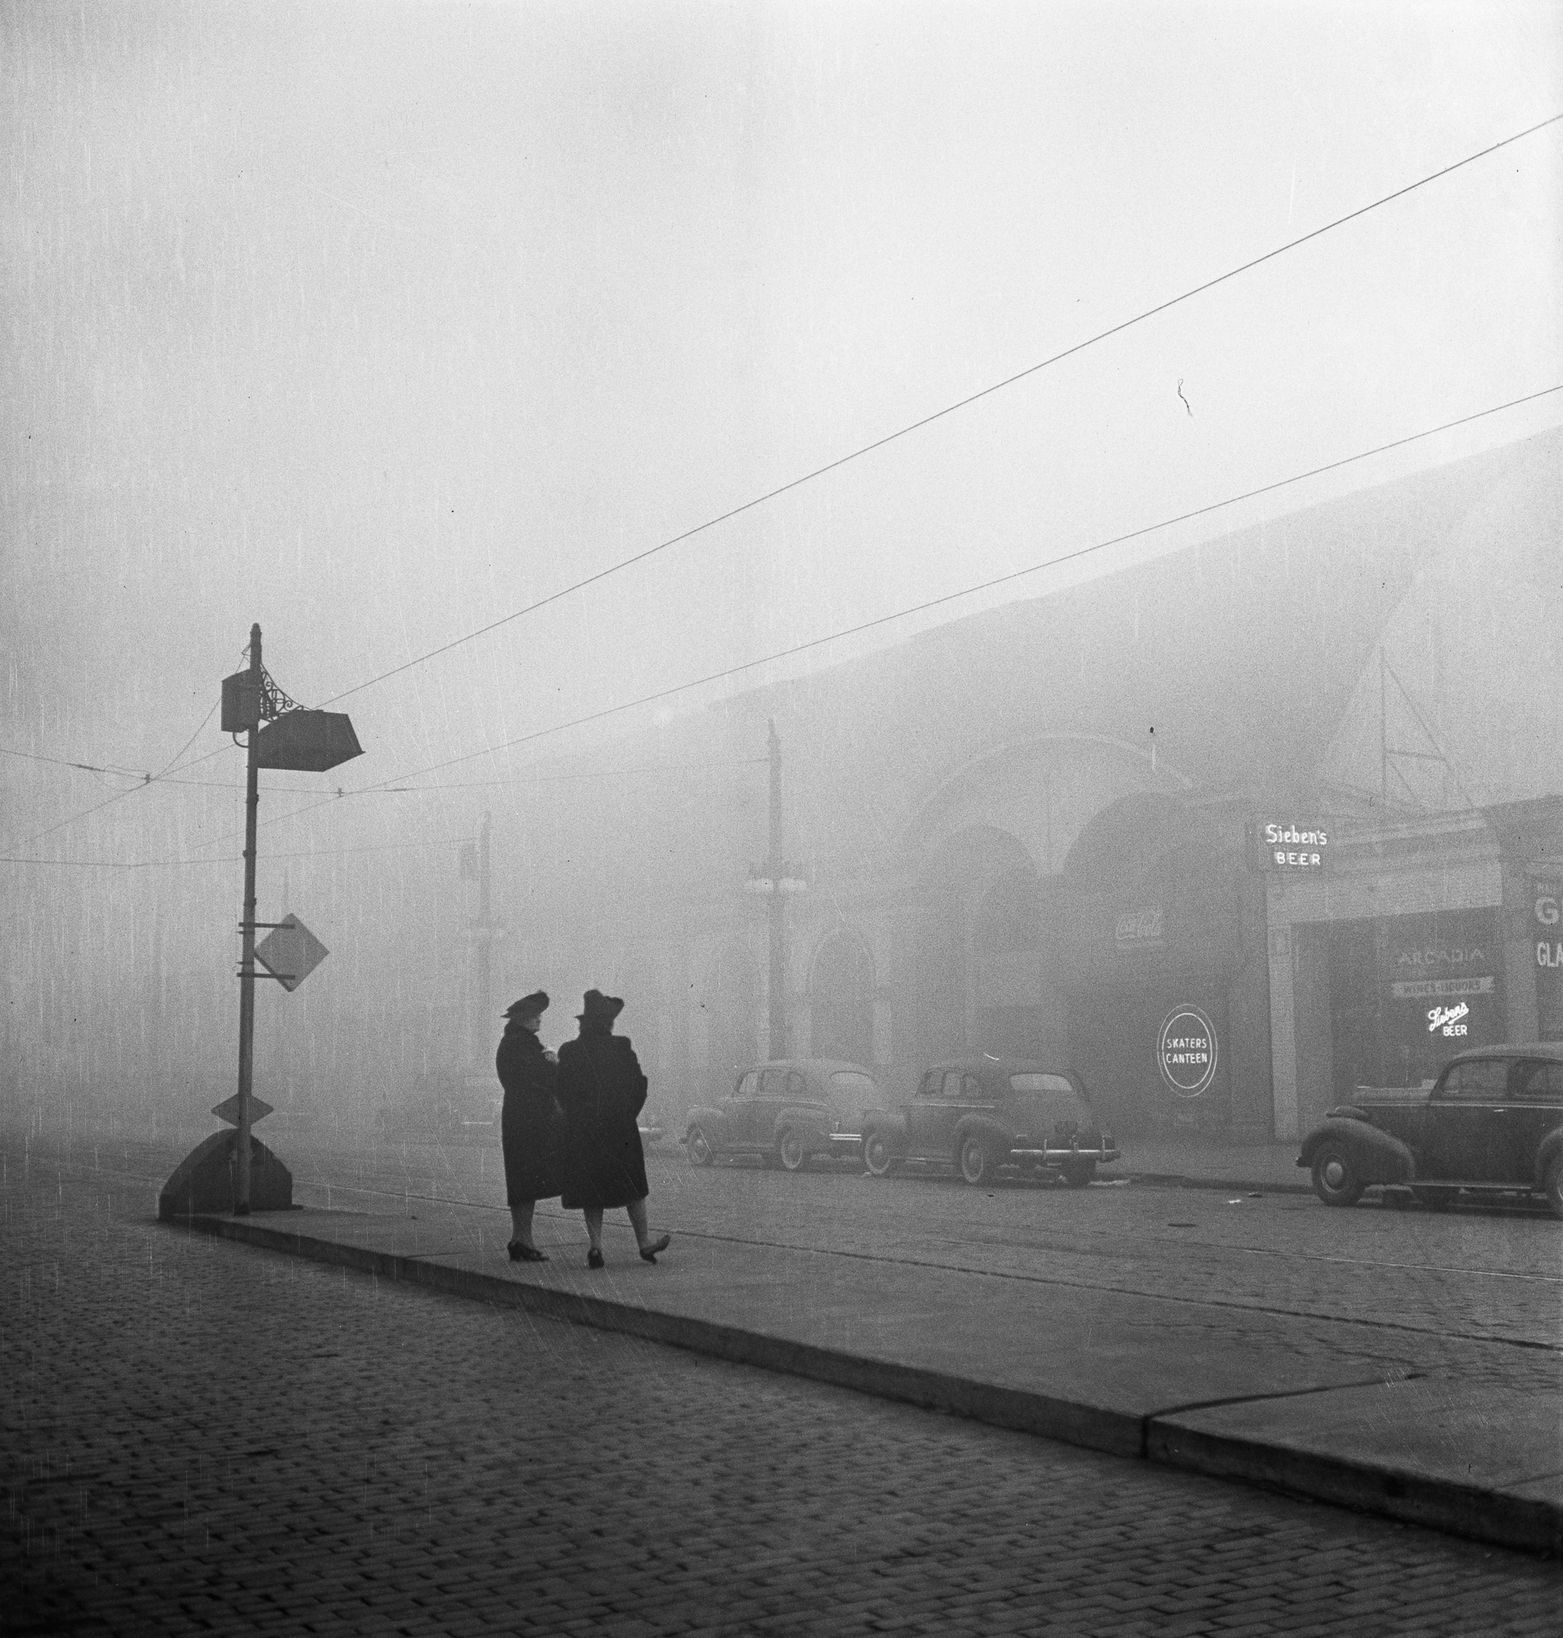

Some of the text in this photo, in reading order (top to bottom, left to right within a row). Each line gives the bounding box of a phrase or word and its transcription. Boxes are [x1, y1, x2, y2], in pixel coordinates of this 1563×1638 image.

[1265, 824, 1327, 845] Sieben's
[1275, 852, 1320, 865] BEER
[1399, 947, 1485, 965] ARCADIA
[1443, 1025, 1467, 1036] BEER
[1167, 1038, 1207, 1049] SKATERS
[1166, 1053, 1208, 1064] CANTEEN
